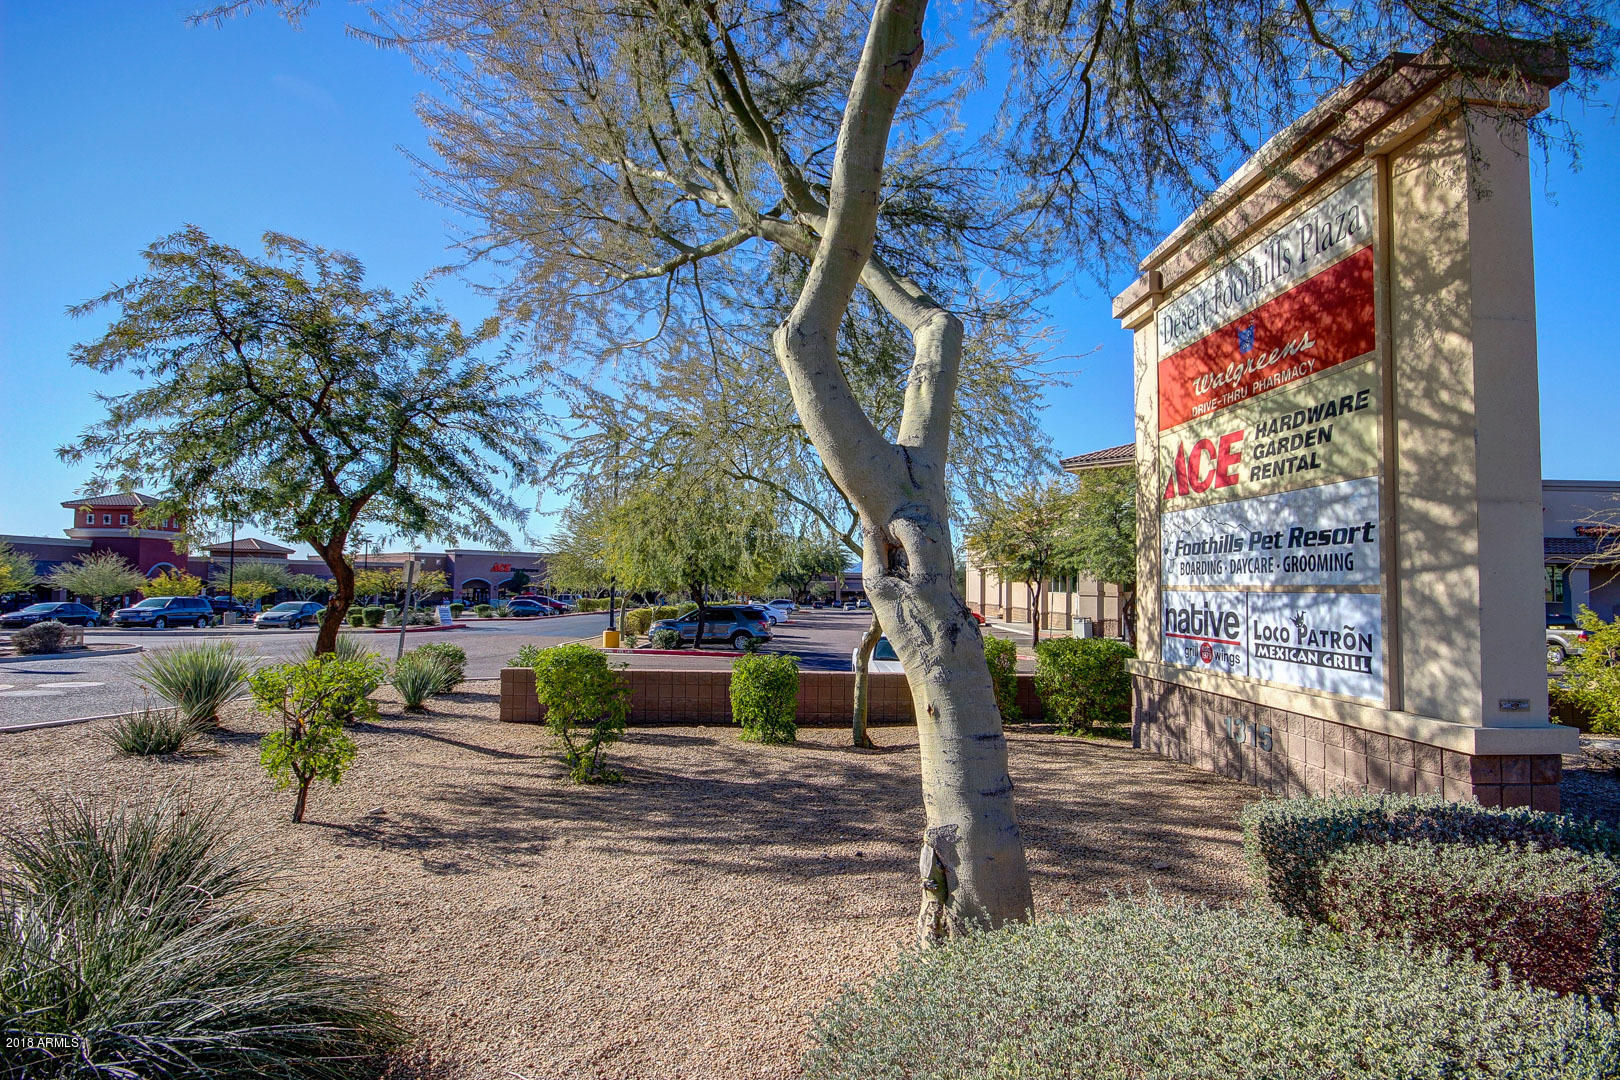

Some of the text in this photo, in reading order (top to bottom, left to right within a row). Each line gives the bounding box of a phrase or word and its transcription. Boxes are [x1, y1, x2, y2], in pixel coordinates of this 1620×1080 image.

[1163, 204, 1362, 344] Desert Foothills Plaza
[1193, 330, 1316, 397] Walgreens
[1191, 358, 1316, 418] DRIVE-THRU PHARMACY
[1254, 388, 1370, 441] HARDWARE
[1253, 423, 1333, 461] GARDEN
[1163, 428, 1245, 500] ACE
[1250, 451, 1321, 483] RENTAL
[1175, 521, 1376, 557] Foothills Pet Resort
[490, 562, 512, 572] ACE
[1180, 552, 1354, 576] BOARDING DAYCARE GROOMING
[1165, 601, 1240, 640] native
[1184, 645, 1199, 659] grill
[1214, 649, 1241, 667] wings
[1256, 643, 1369, 672] MEXICAN GRILL
[1223, 715, 1273, 752] 1315
